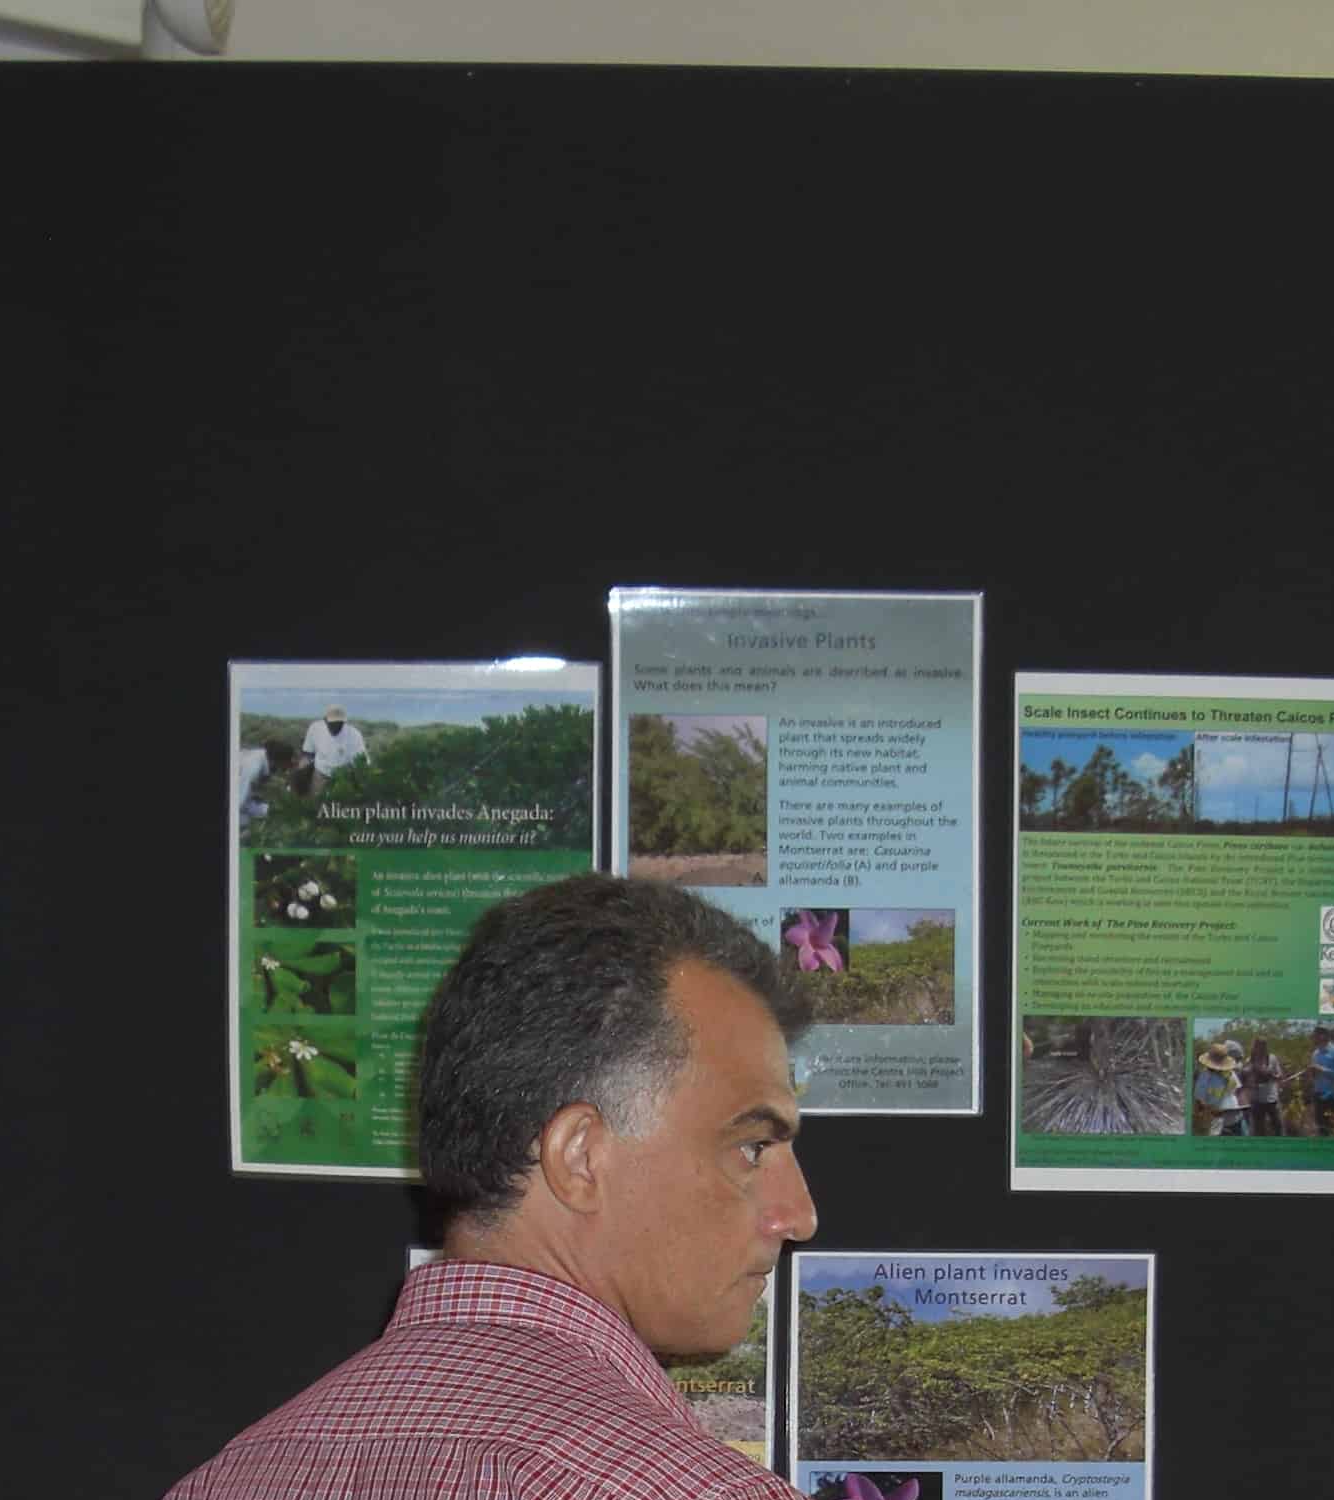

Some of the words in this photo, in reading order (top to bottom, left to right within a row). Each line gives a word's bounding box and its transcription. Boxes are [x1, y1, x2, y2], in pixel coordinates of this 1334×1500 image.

[727, 631, 809, 650] Invasive
[814, 632, 877, 651] Plants
[634, 664, 667, 676] Some
[673, 665, 713, 679] plants
[633, 680, 669, 693] What
[672, 681, 701, 693] does
[706, 682, 731, 694] this
[732, 682, 778, 695] mean?
[1022, 705, 1064, 719] Scale
[1066, 705, 1110, 721] Insect
[1114, 706, 1188, 722] Continues
[1191, 708, 1206, 722] to
[1210, 708, 1273, 724] Threaten
[1276, 710, 1326, 725] Caicos
[779, 718, 796, 729] An
[799, 718, 845, 729] invasive
[878, 718, 942, 730] introduced
[779, 732, 810, 745] plant
[812, 732, 838, 744] that
[840, 733, 884, 746] spreads
[887, 734, 927, 746] widely
[778, 747, 827, 761] through
[846, 750, 872, 759] new
[778, 762, 829, 774] harming
[830, 762, 869, 774] native
[870, 763, 902, 775] plant
[904, 763, 928, 774] and
[778, 777, 819, 788] animal
[316, 799, 361, 821] Alien
[363, 800, 408, 824] plant
[410, 800, 474, 821] invades
[475, 803, 555, 825] Anegada:
[779, 800, 813, 811] There
[815, 802, 835, 811] are
[837, 802, 871, 813] many
[872, 801, 928, 813] examples
[930, 801, 944, 812] of
[778, 815, 825, 826] invasive
[827, 815, 865, 828] plants
[866, 815, 935, 828] throughout
[937, 816, 958, 828] the
[348, 832, 375, 844] can
[376, 832, 404, 848] you
[406, 828, 437, 848] help
[439, 832, 457, 844] us
[458, 830, 516, 845] monitor
[518, 830, 538, 844] it?
[818, 830, 845, 841] Two
[847, 830, 903, 843] examples
[778, 845, 845, 856] Montserrat
[873, 845, 932, 857] Casuarina
[854, 860, 873, 873] (A)
[874, 860, 899, 872] and
[899, 861, 940, 873] purple
[778, 874, 840, 887] allamanda
[1021, 918, 1061, 928] Current
[1063, 919, 1091, 928] Work
[1091, 919, 1102, 930] of
[1107, 919, 1127, 929] The
[1127, 920, 1150, 929] Pine
[1151, 920, 1197, 930] Recovery
[873, 1263, 926, 1281] Alien
[933, 1263, 986, 1285] plant
[993, 1264, 1069, 1282] invades
[914, 1287, 1028, 1307] Montserrat
[673, 1378, 756, 1395] ntserrat
[954, 1473, 992, 1485] Purple
[994, 1473, 1057, 1485] allamanda,
[1082, 1488, 1108, 1498] alien
